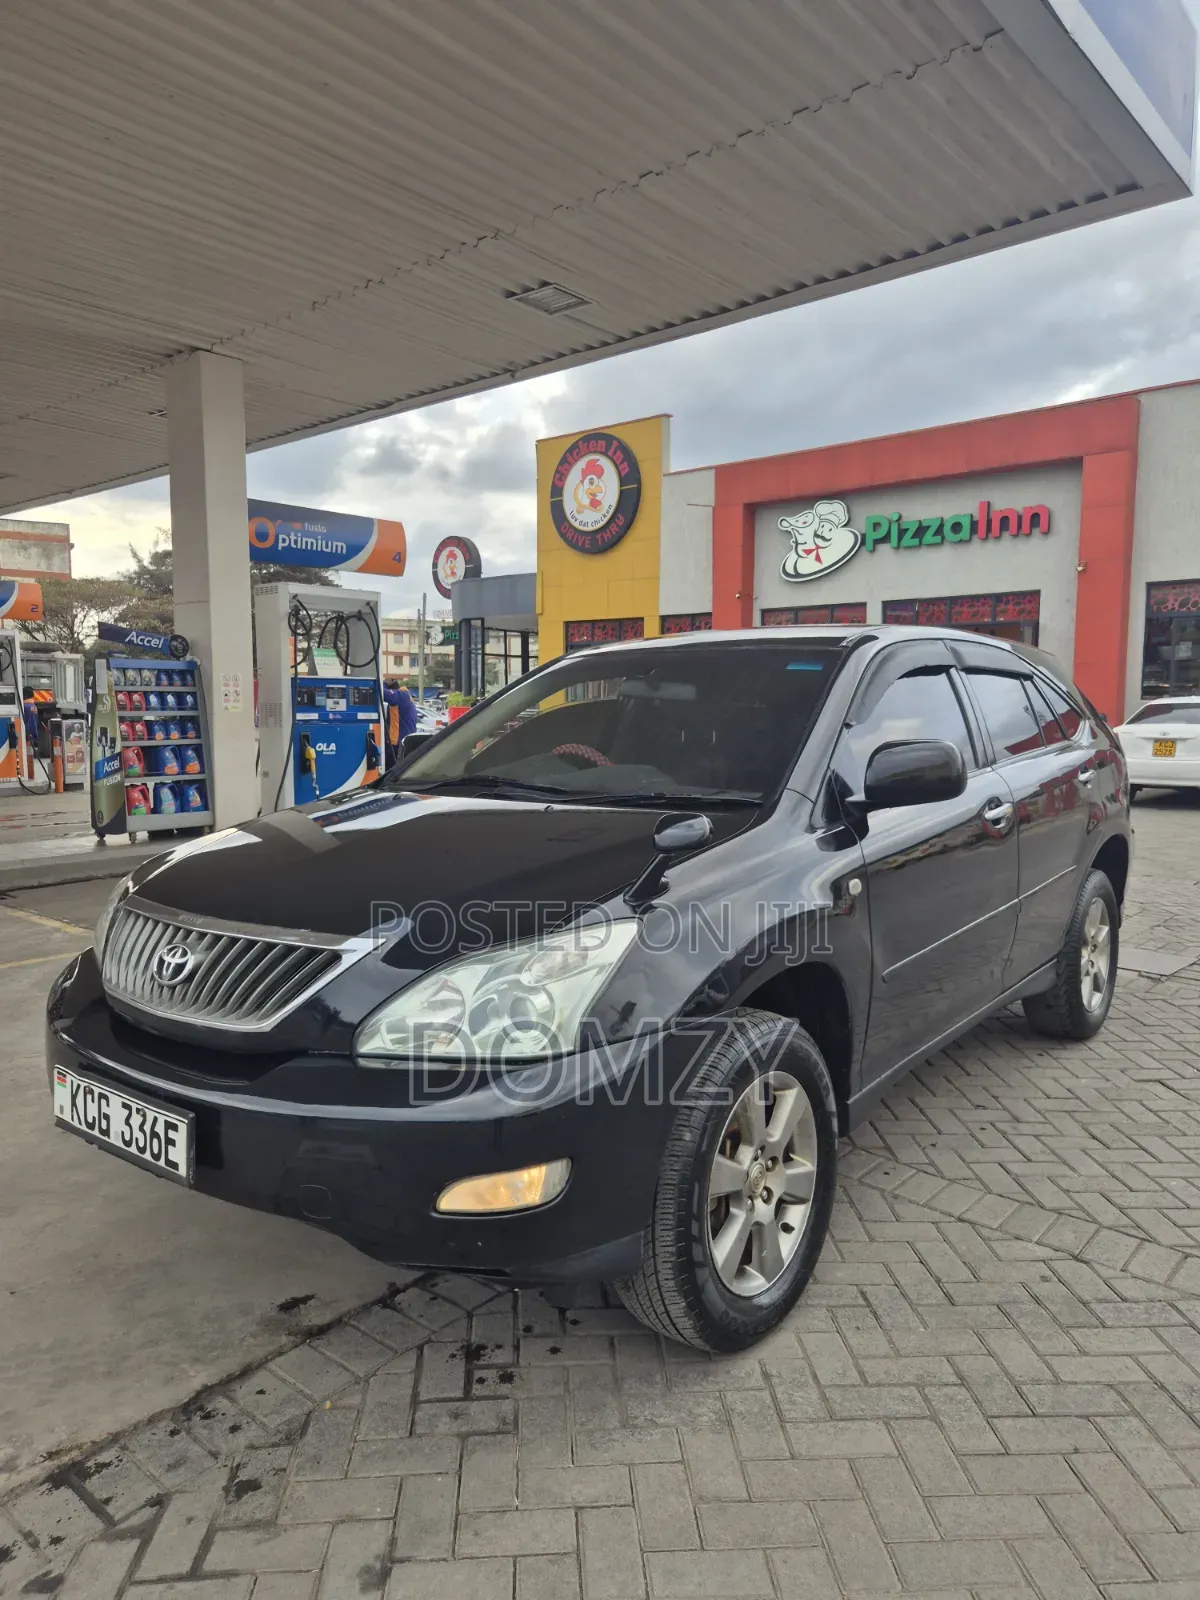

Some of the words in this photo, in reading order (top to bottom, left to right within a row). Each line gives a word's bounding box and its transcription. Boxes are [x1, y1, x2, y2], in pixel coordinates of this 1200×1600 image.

[554, 440, 607, 488] Chicken
[608, 440, 630, 476] Inn
[579, 519, 589, 528] dat
[591, 504, 613, 528] chicken
[304, 521, 327, 533] fuels
[560, 521, 592, 548] DRIVE
[596, 513, 625, 545] THRU
[392, 551, 402, 564] 4
[30, 603, 39, 613] 2
[125, 630, 164, 649] Accel
[444, 630, 459, 640] Pizz
[316, 742, 336, 751] OLA
[1154, 748, 1173, 756] 252S
[103, 756, 120, 774] Accel
[103, 774, 121, 787] FUSION
[70, 1079, 111, 1140] KCG
[121, 1101, 180, 1172] 336E
